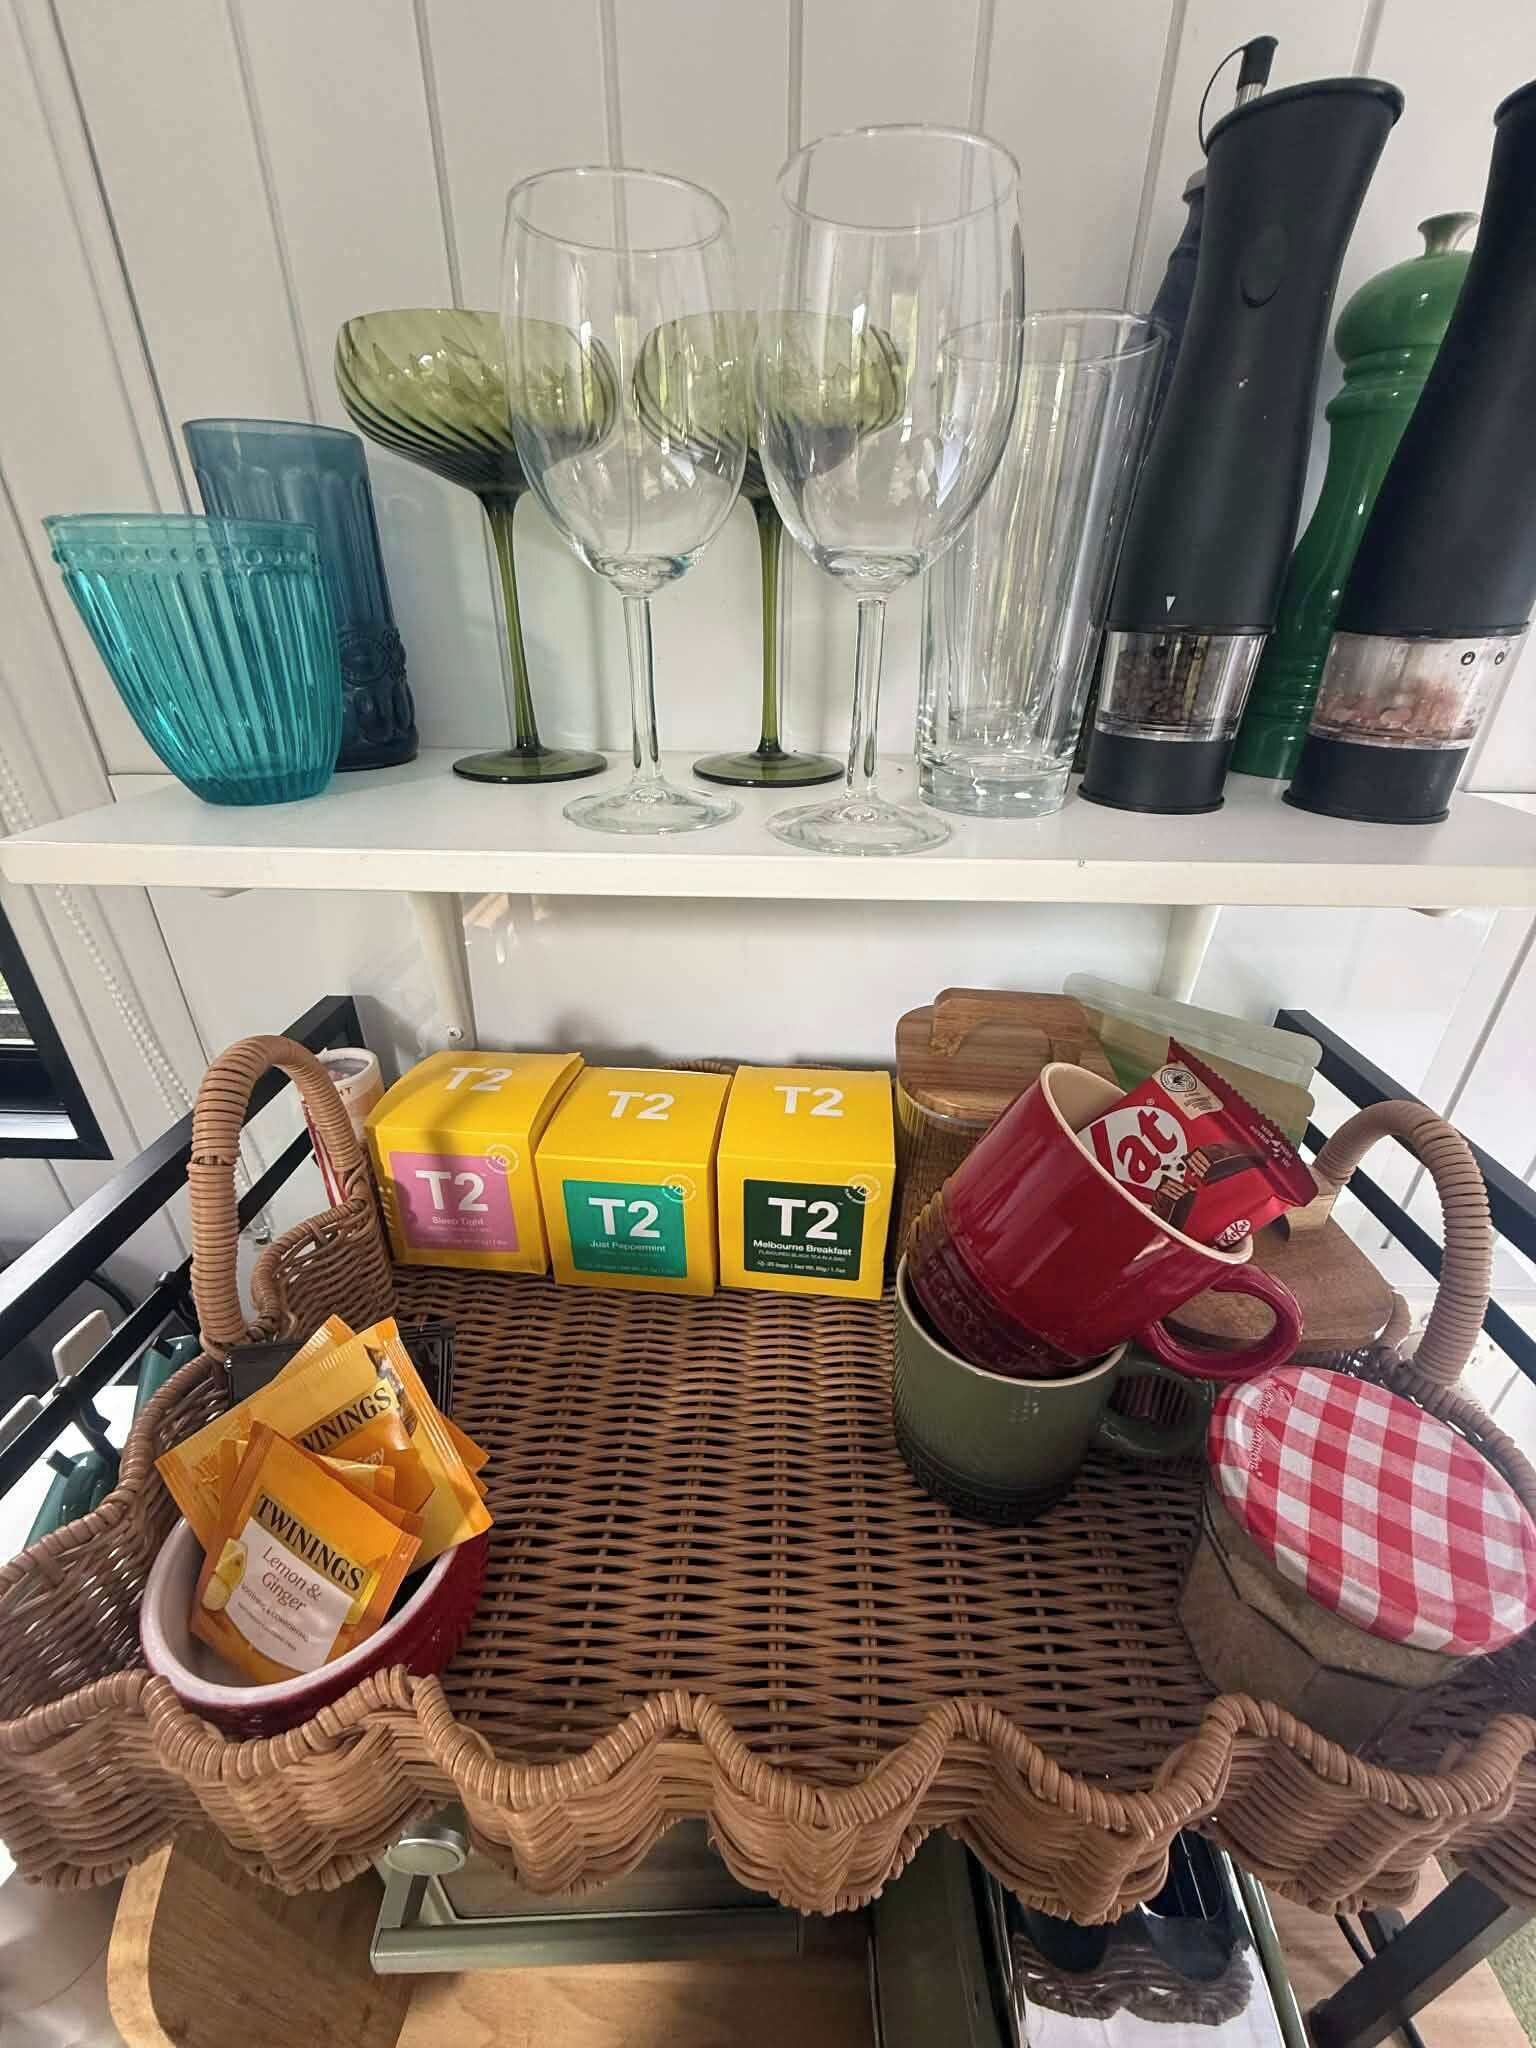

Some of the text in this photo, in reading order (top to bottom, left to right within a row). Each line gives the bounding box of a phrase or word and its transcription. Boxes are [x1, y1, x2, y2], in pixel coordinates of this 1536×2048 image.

[446, 1067, 513, 1092] T2
[608, 1090, 675, 1120] T2
[774, 1085, 844, 1117] T2
[415, 1170, 489, 1211] T2
[588, 1197, 660, 1238] T2
[768, 1197, 839, 1240] T2
[590, 1240, 610, 1249] Just
[753, 1240, 852, 1256] Melbourne Breakfast
[257, 1493, 364, 1591] TWININGS
[262, 1545, 322, 1600] Lemon &
[262, 1572, 307, 1611] Ginger
